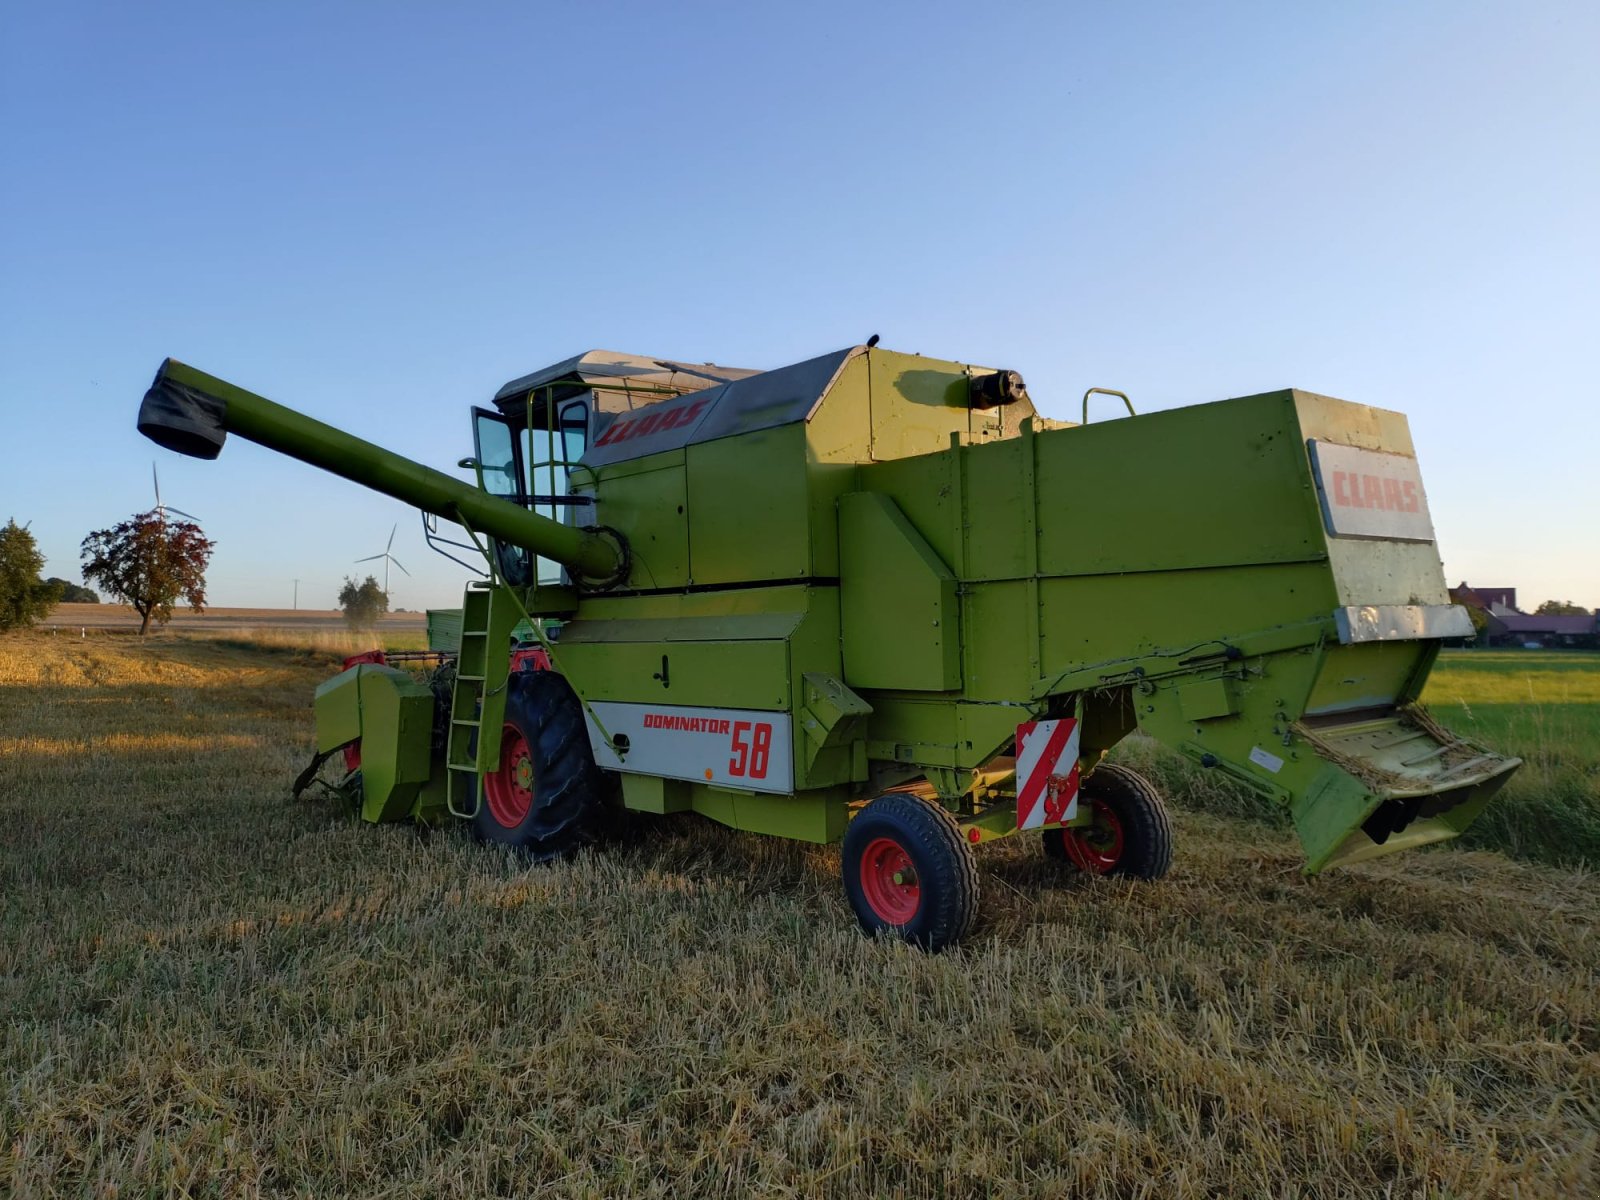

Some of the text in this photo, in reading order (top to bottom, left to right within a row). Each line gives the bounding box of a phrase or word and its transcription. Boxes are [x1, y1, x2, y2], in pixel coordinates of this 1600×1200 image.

[594, 400, 711, 448] CLAAS
[1332, 471, 1419, 513] CLAAS
[643, 713, 772, 779] DOMINATOR 58
